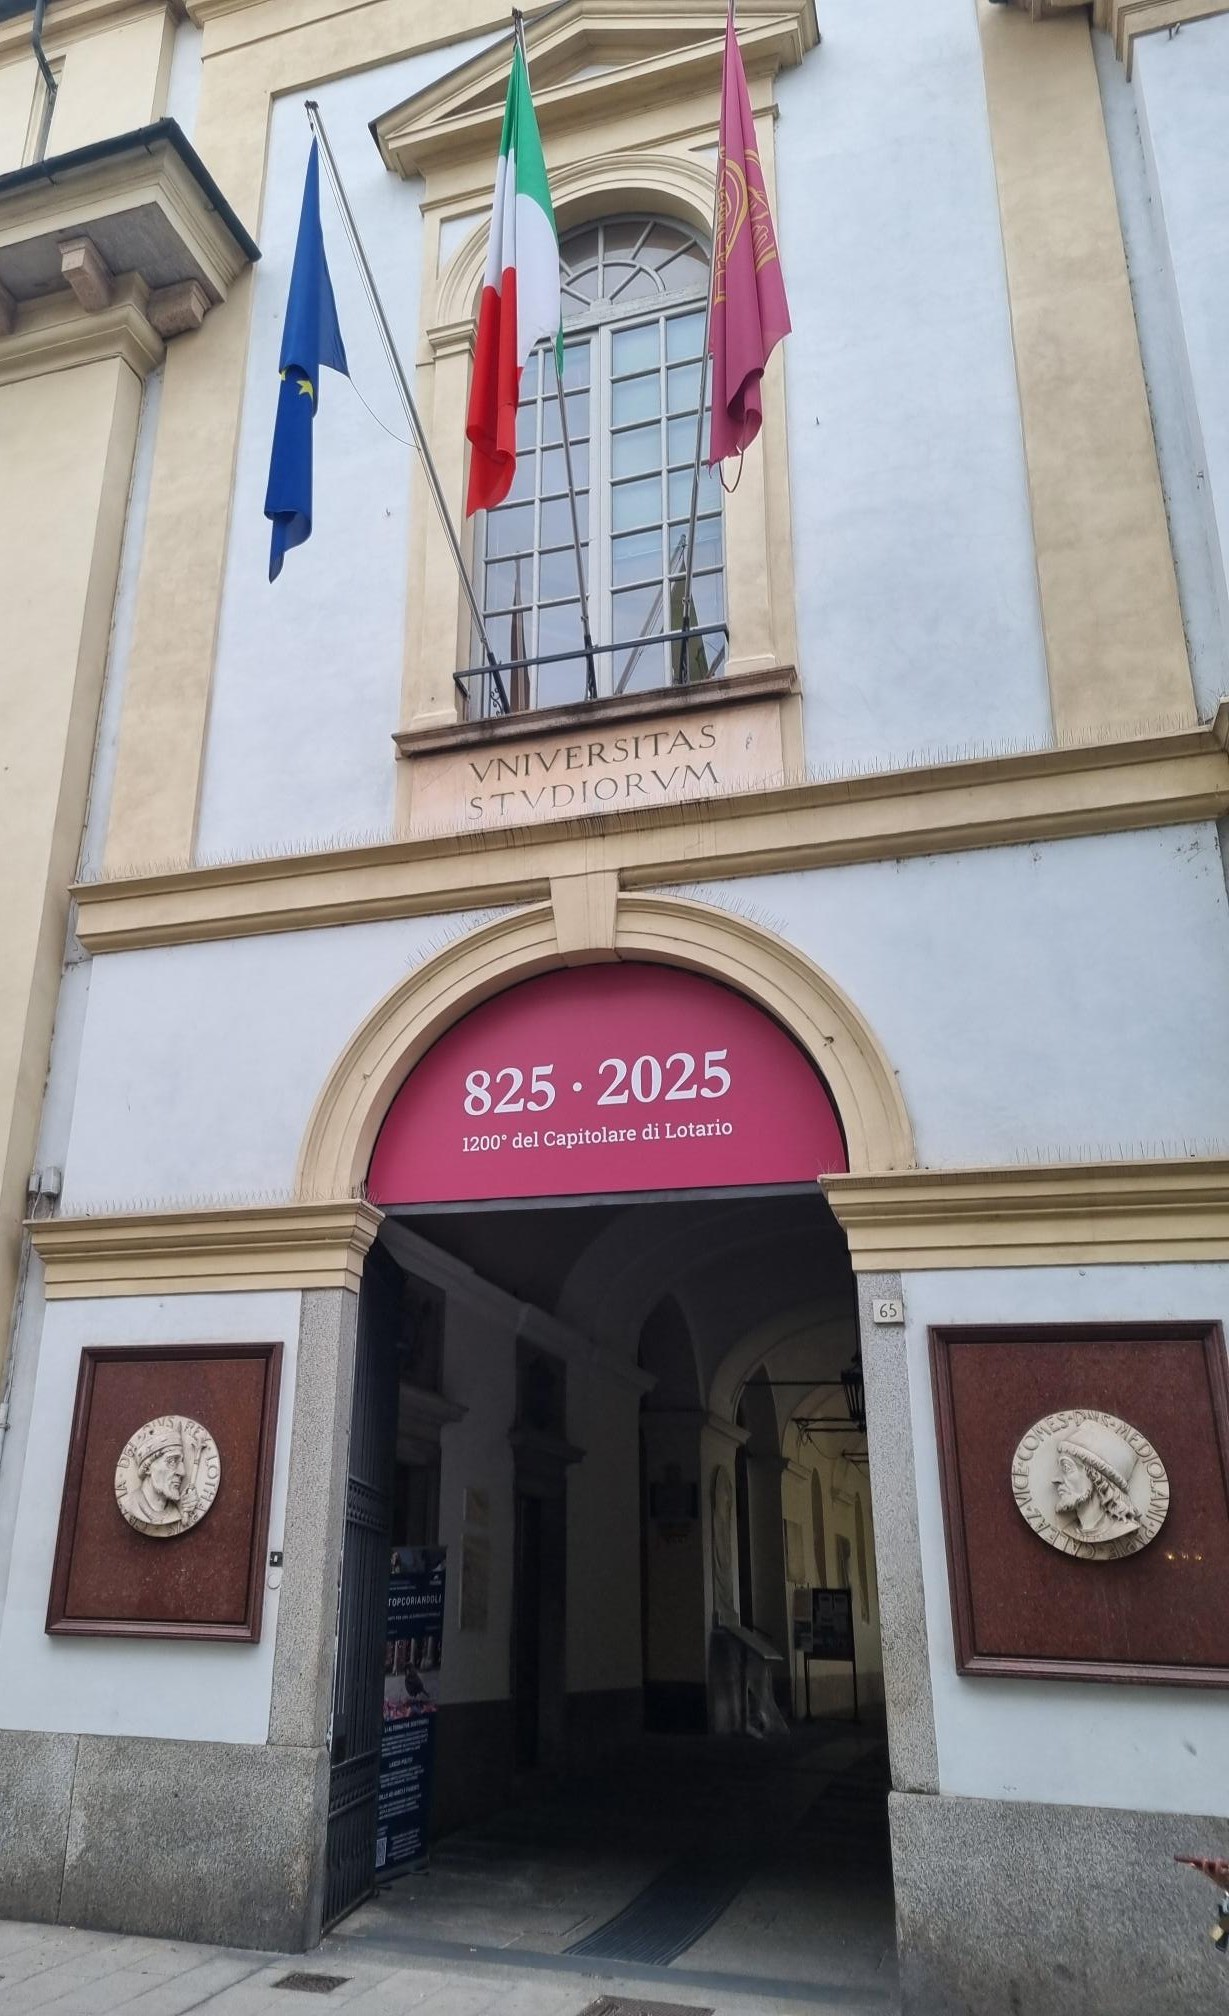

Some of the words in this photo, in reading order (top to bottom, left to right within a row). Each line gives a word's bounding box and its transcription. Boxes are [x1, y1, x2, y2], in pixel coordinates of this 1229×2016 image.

[468, 724, 717, 784] VNIVERSITAS
[468, 761, 720, 821] STVDIORVM
[463, 1064, 556, 1116] 825
[597, 1049, 731, 1105] 2025
[462, 1134, 507, 1152] 1200°
[512, 1131, 539, 1149] del
[544, 1127, 637, 1150] Capitolare
[642, 1123, 660, 1140] di
[665, 1119, 733, 1139] Lotario
[879, 1303, 897, 1318] 65
